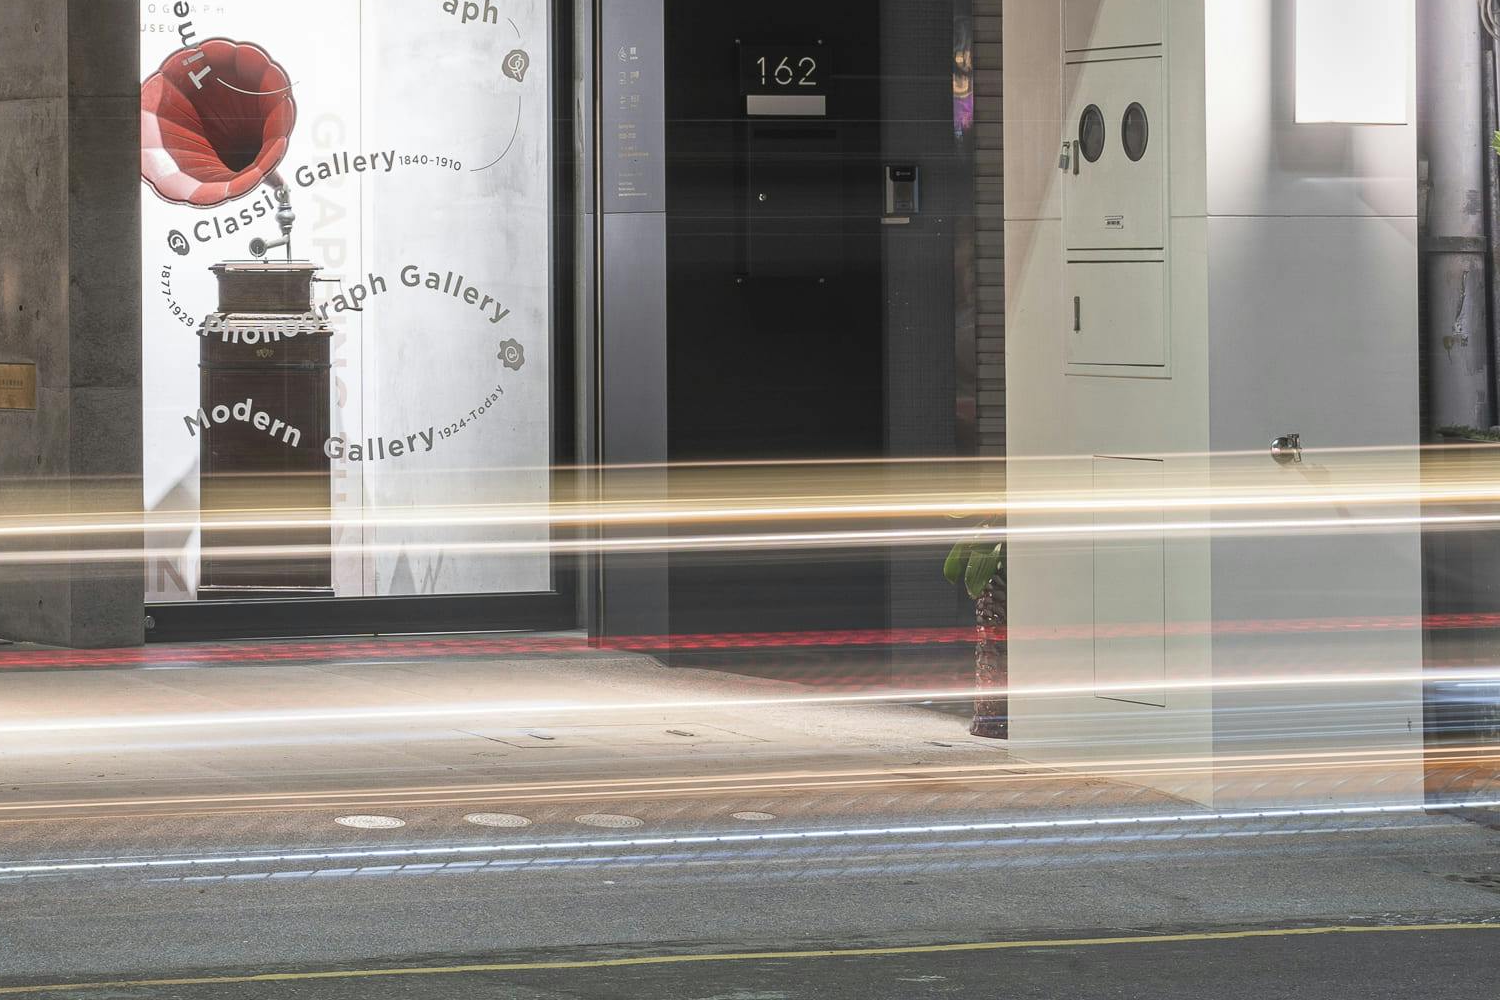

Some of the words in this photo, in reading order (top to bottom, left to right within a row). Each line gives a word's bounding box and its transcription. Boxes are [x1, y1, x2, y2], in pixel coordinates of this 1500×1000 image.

[173, 0, 212, 90] Time
[756, 56, 817, 86] 162
[193, 187, 288, 243] Classic
[295, 150, 396, 188] Gallery
[398, 154, 462, 171] 1840-1910
[161, 264, 195, 327] 1877-1929
[202, 273, 387, 345] Phonograph
[400, 265, 511, 324] Gallery
[183, 398, 302, 449] Modern
[323, 426, 435, 463] Gallery
[437, 383, 506, 441] 1924-Today
